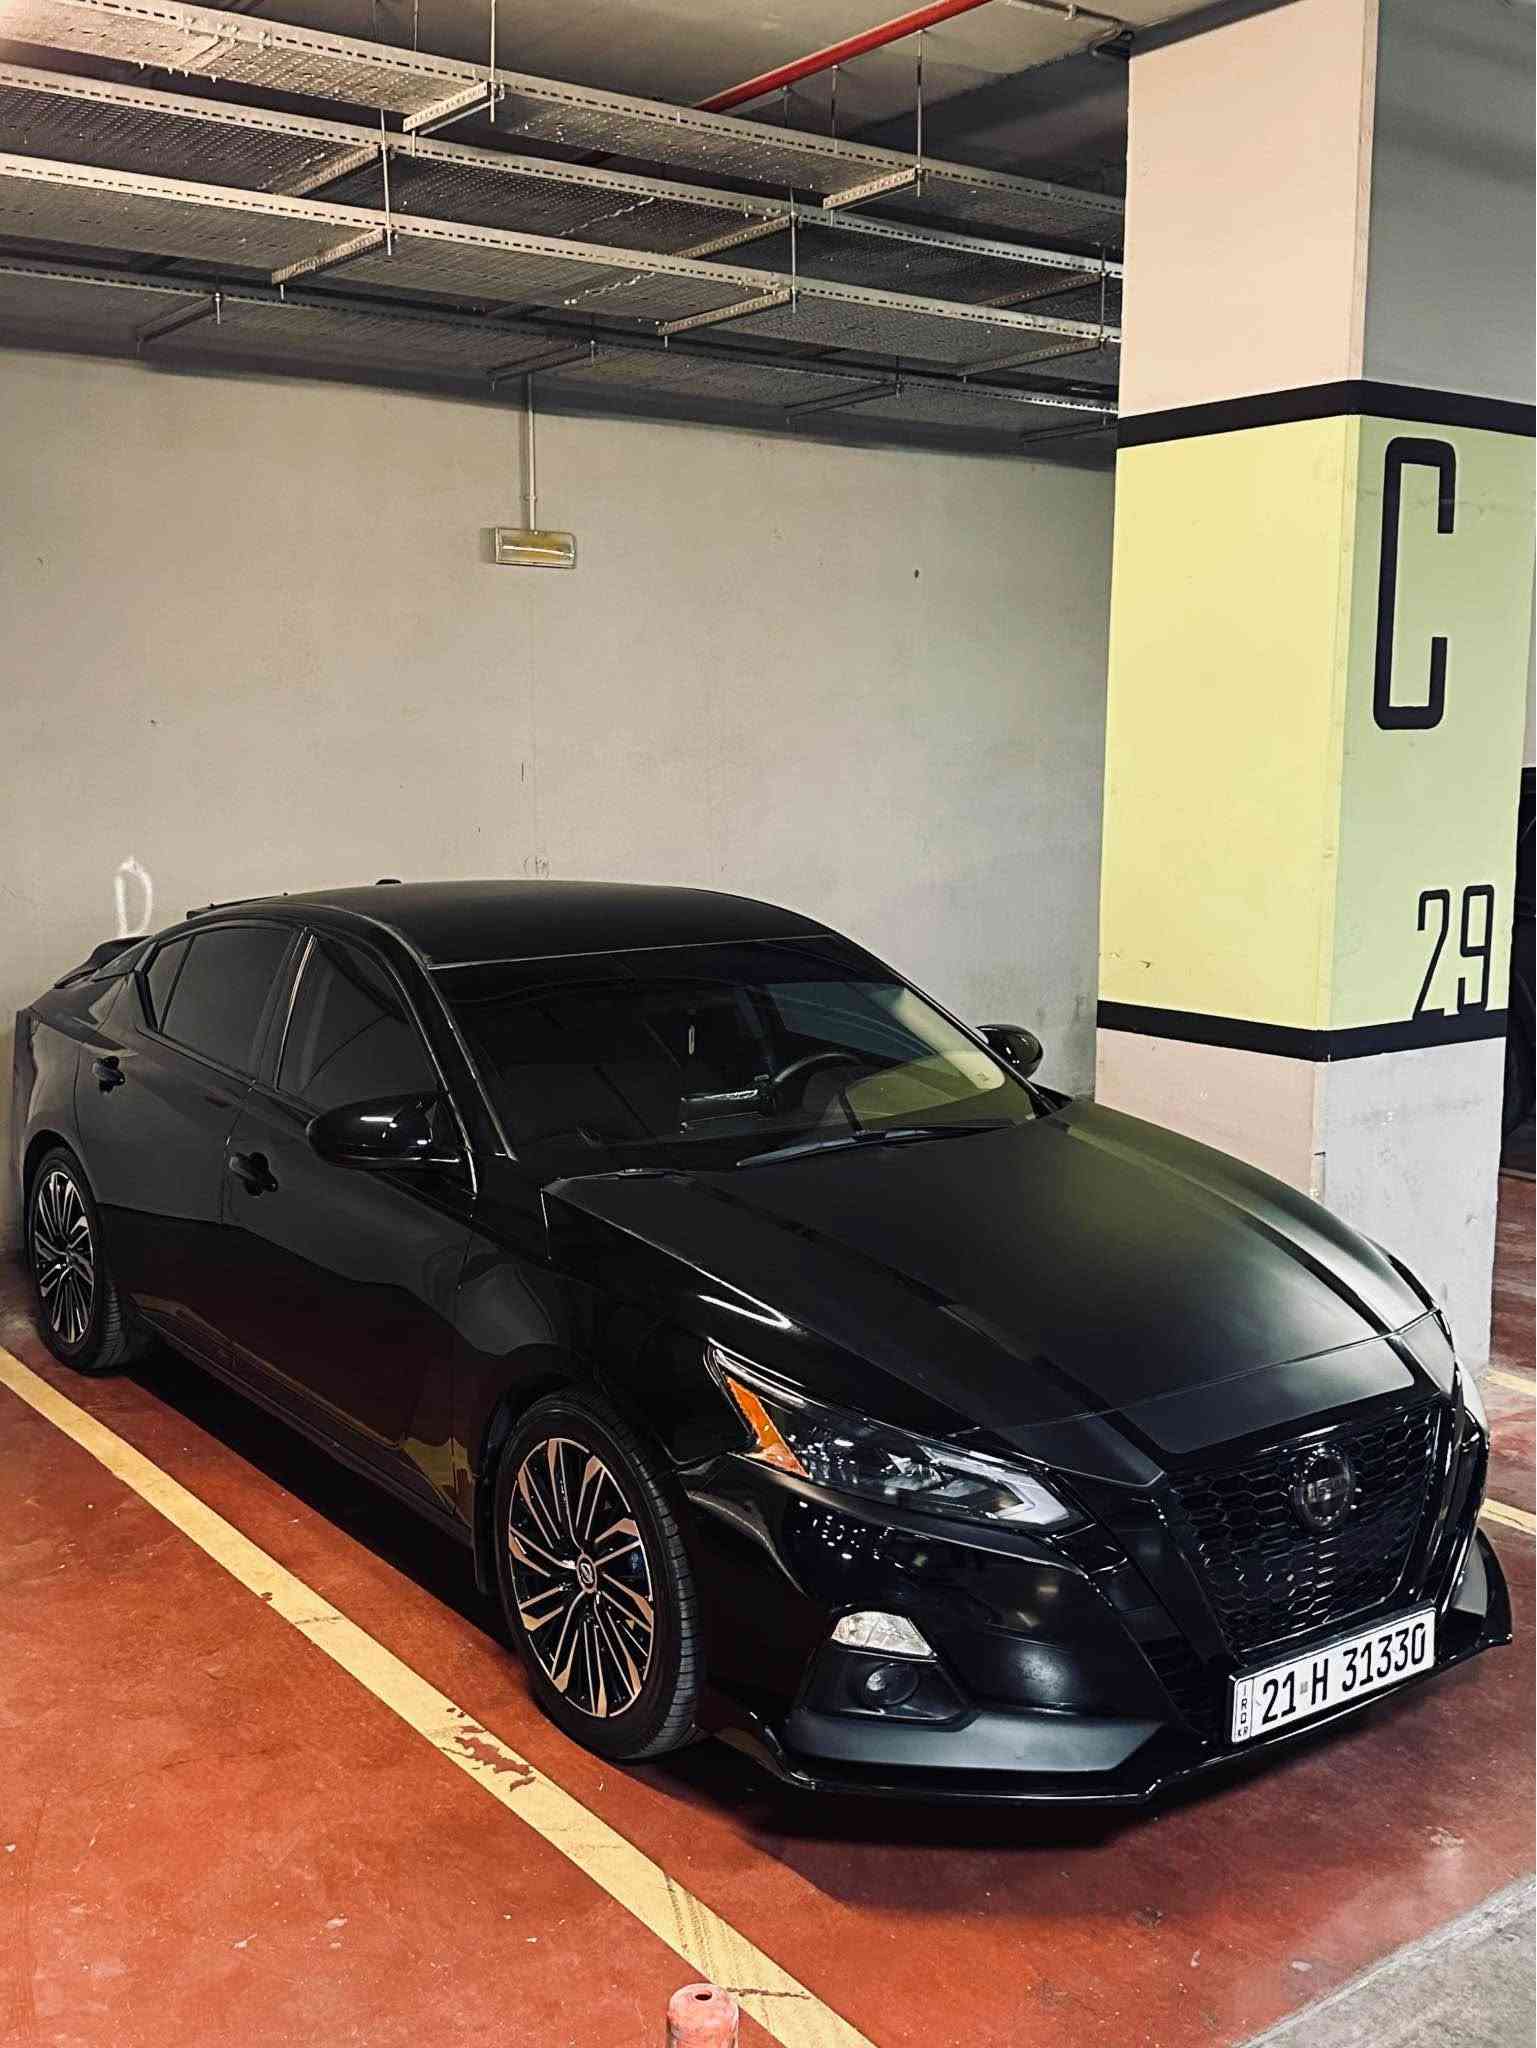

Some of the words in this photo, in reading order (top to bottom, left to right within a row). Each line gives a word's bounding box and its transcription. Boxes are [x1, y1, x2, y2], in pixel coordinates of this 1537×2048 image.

[1373, 436, 1456, 730] C
[1412, 884, 1494, 1018] 29
[1261, 1670, 1297, 1725] 21
[1310, 1657, 1329, 1705] H
[1341, 1622, 1426, 1692] 31330
